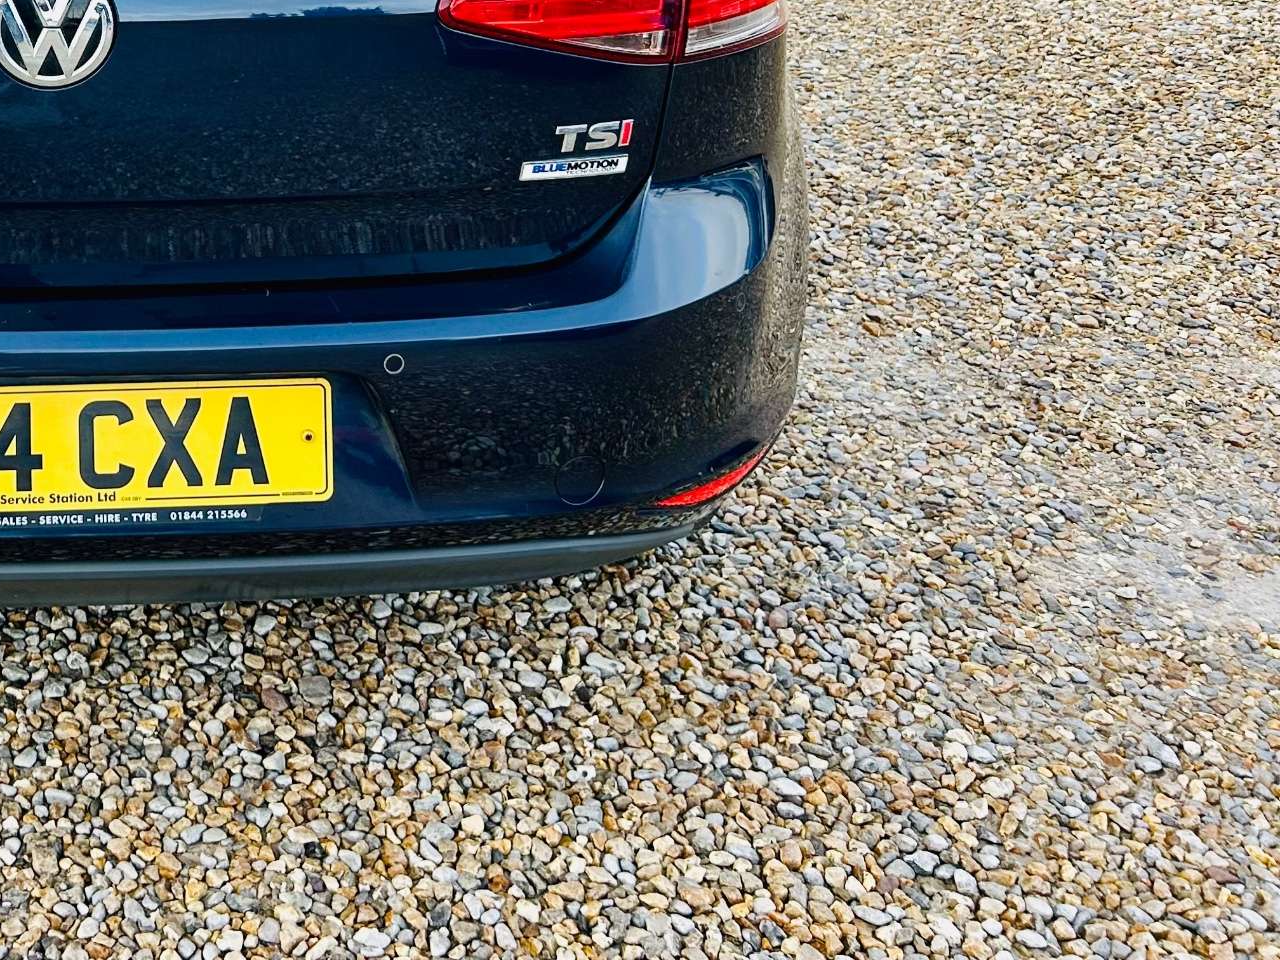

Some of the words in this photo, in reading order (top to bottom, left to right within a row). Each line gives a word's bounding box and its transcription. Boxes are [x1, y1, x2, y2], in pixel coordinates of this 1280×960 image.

[555, 118, 634, 153] TSI
[531, 158, 619, 174] BLUEMOTION
[78, 395, 272, 490] CXA
[0, 493, 45, 505] Service
[49, 491, 93, 504] Station
[96, 490, 117, 502] Ltd
[39, 513, 84, 525] SERVICE
[95, 513, 121, 524] HIRE
[131, 511, 158, 523] TYRE
[170, 511, 204, 521] 01844
[207, 508, 248, 520] 215566
